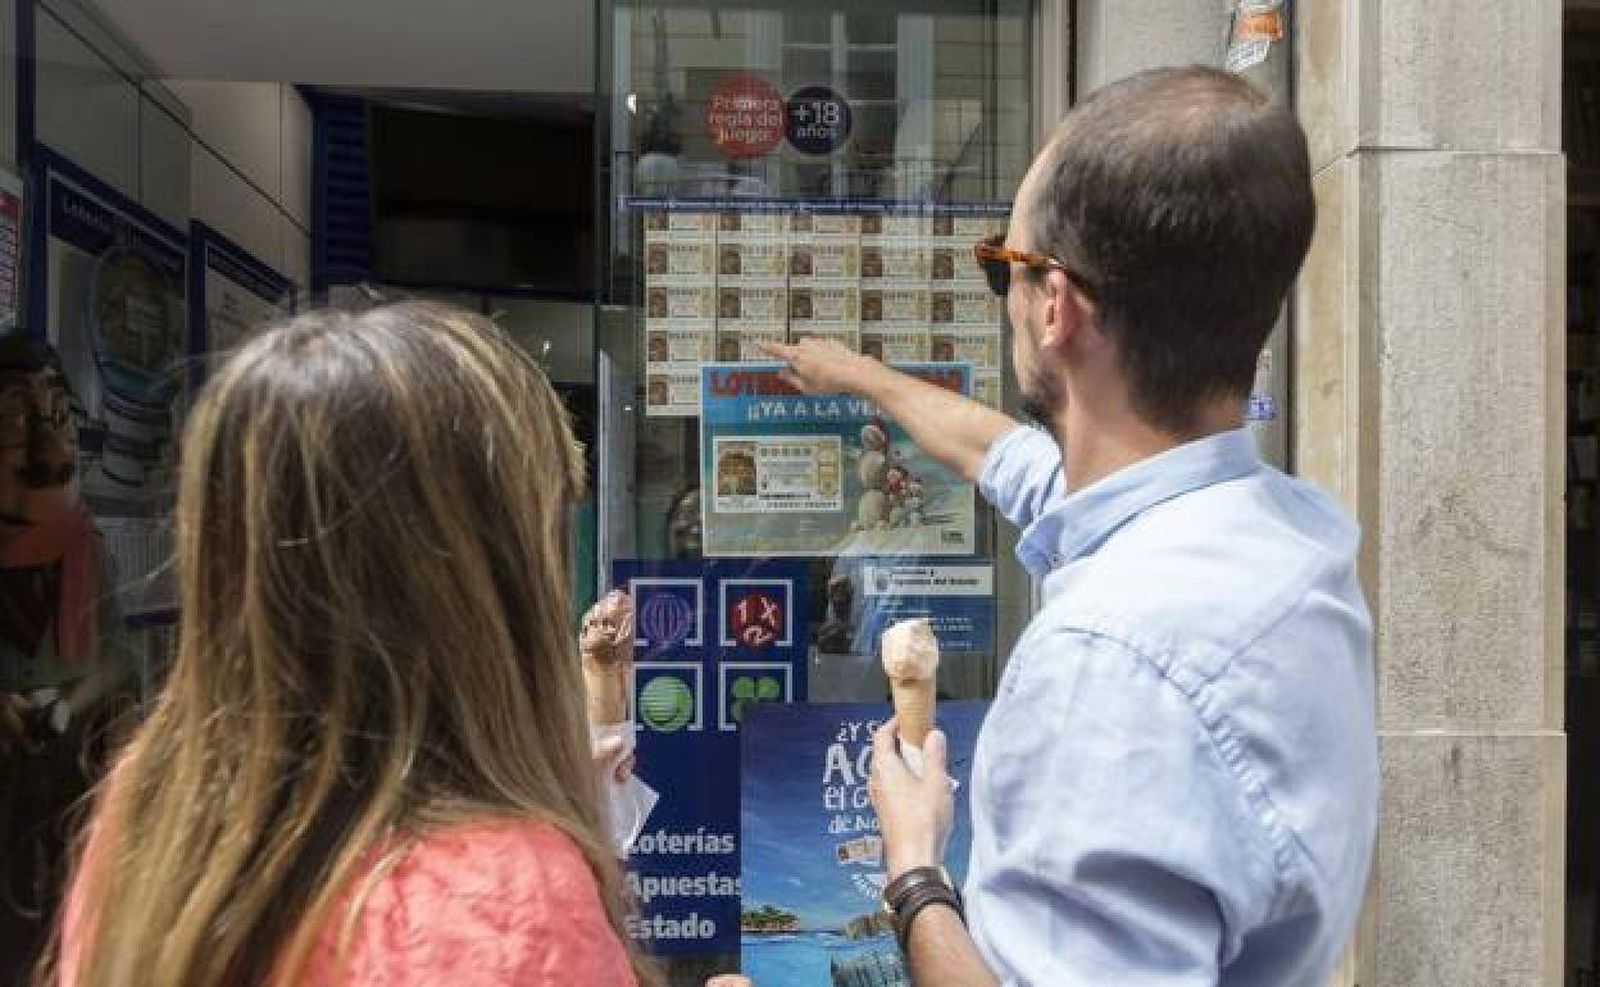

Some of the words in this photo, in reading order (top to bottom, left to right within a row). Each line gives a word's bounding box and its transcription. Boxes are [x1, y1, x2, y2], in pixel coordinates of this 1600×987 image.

[757, 111, 783, 126] del
[791, 102, 840, 123] +18
[794, 402, 806, 416] A
[815, 401, 840, 416] LA
[825, 786, 845, 810] el
[629, 827, 734, 854] oterías
